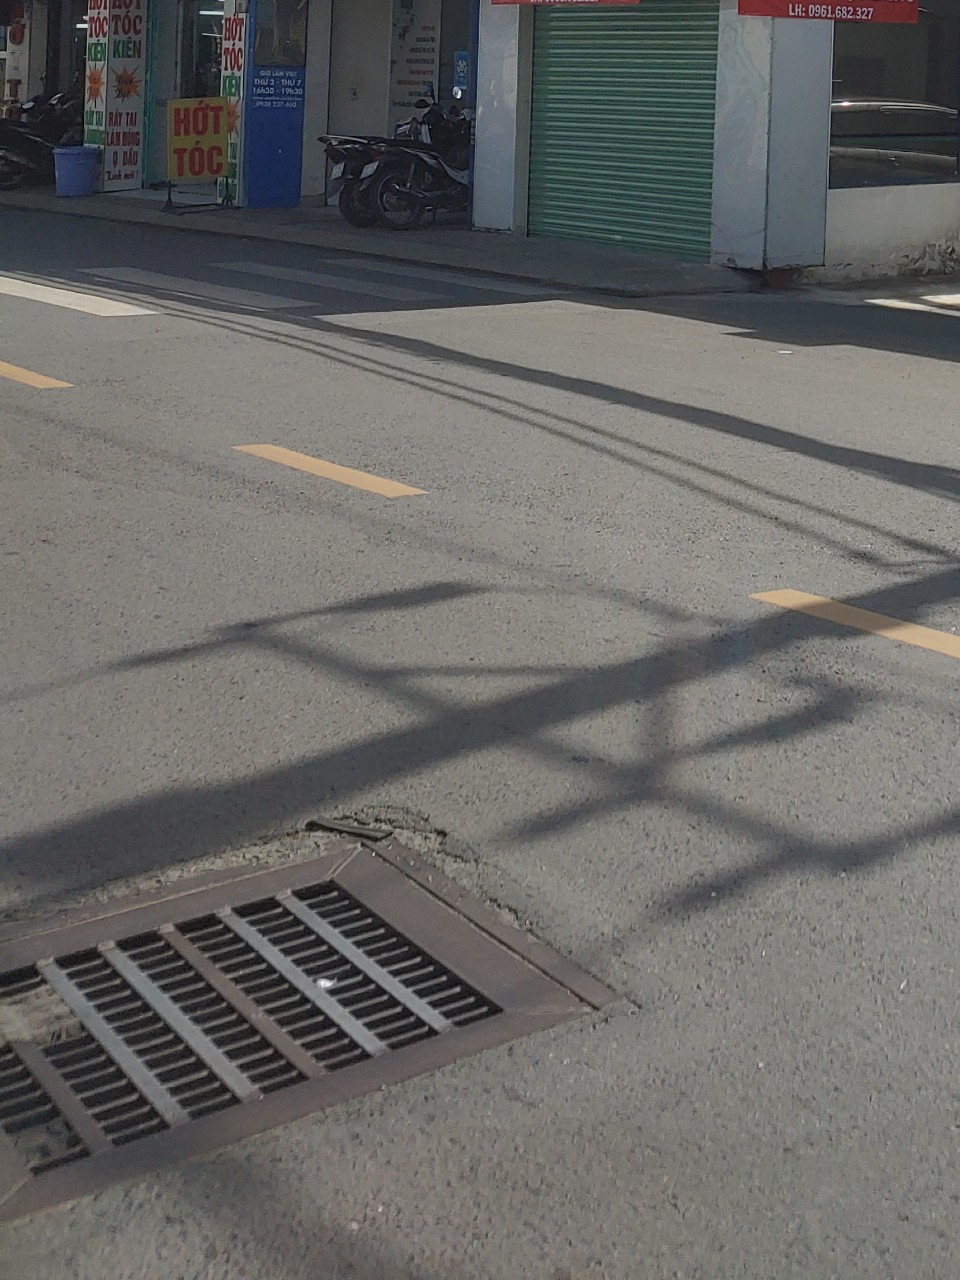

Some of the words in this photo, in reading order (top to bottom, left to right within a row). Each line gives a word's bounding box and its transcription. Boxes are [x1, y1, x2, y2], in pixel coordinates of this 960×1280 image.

[89, 11, 108, 38] TÓC
[112, 11, 143, 36] TÓC
[788, 3, 806, 17] LH:
[808, 4, 874, 20] 0961.682.327
[224, 14, 244, 42] HỚT
[113, 36, 142, 59] KIÊN
[223, 42, 243, 72] TÓC
[253, 86, 275, 94] 16h30
[281, 87, 303, 95] 19h30
[109, 108, 123, 127] RÁY
[126, 112, 137, 127] TAI
[173, 100, 224, 137] HỚT
[173, 140, 224, 178] TÓC
